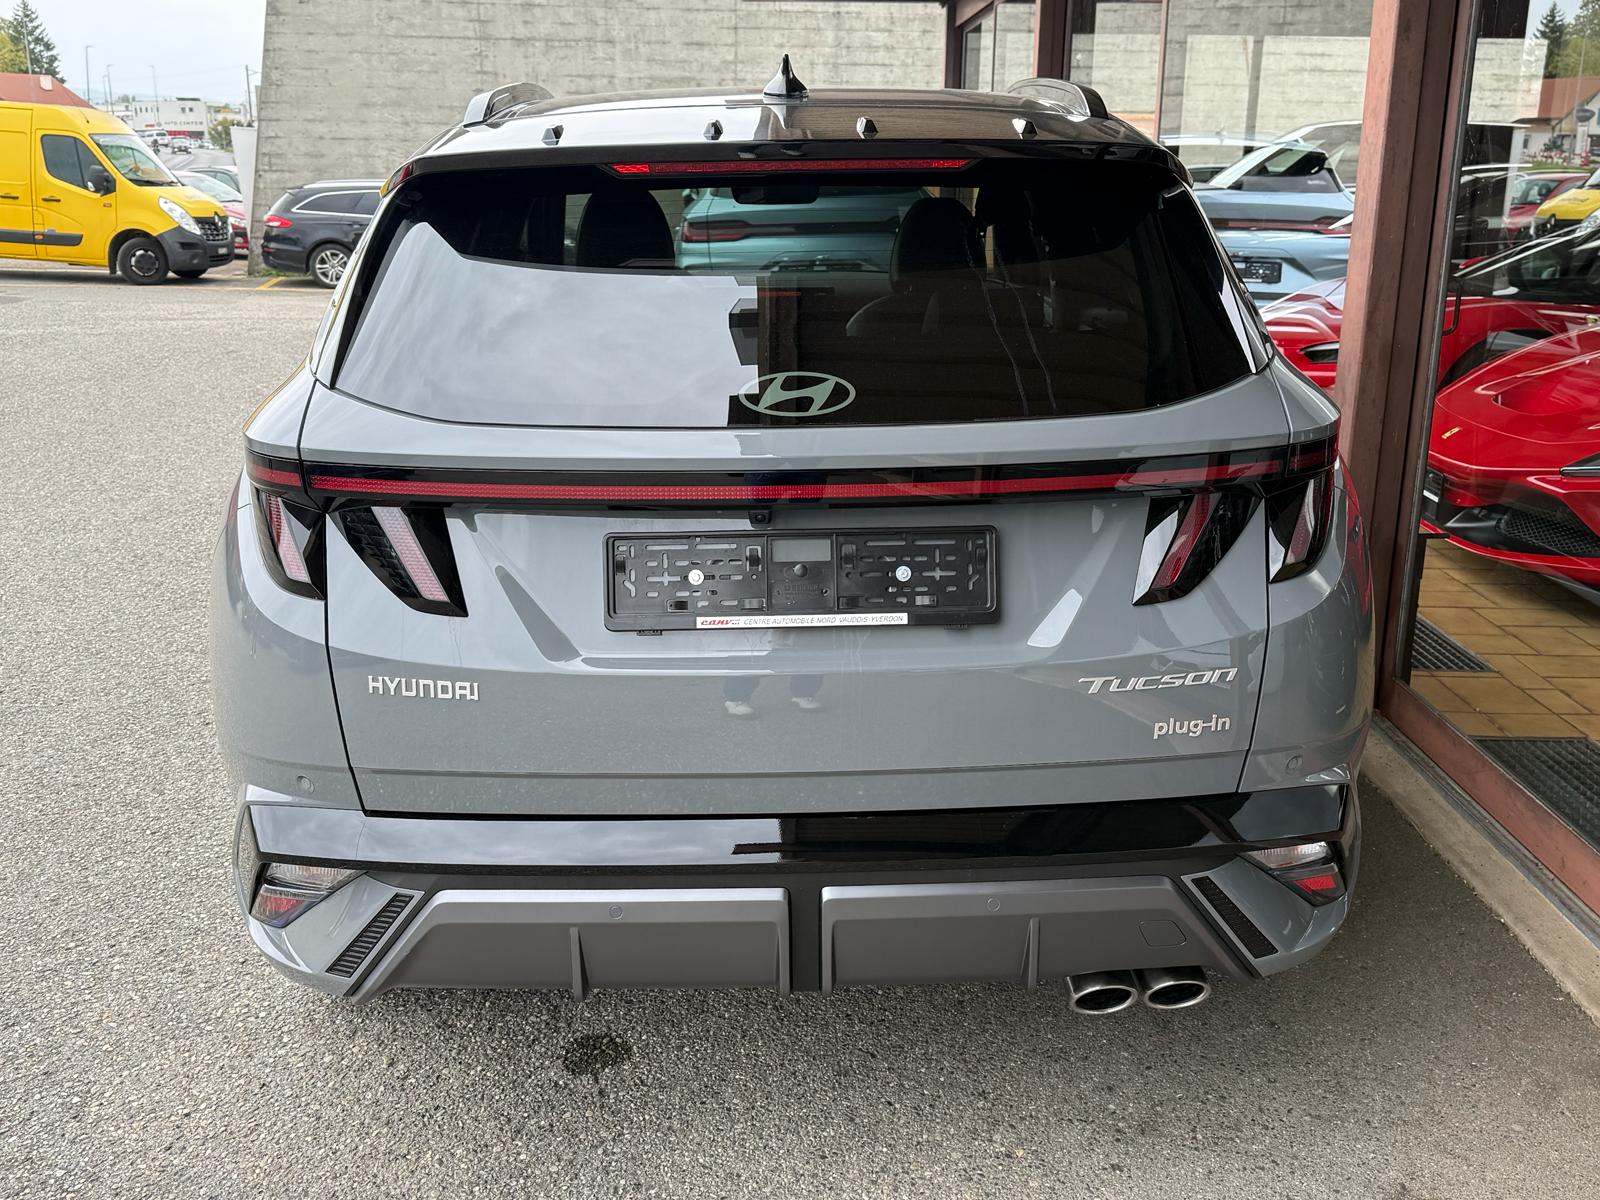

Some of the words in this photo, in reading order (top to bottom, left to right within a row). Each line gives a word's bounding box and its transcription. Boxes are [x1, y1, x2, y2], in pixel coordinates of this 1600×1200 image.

[772, 616, 815, 625] AUTOMOBILE
[816, 616, 837, 624] NORD
[368, 675, 479, 700] HYUNDAI
[1153, 714, 1231, 739] plug-in
